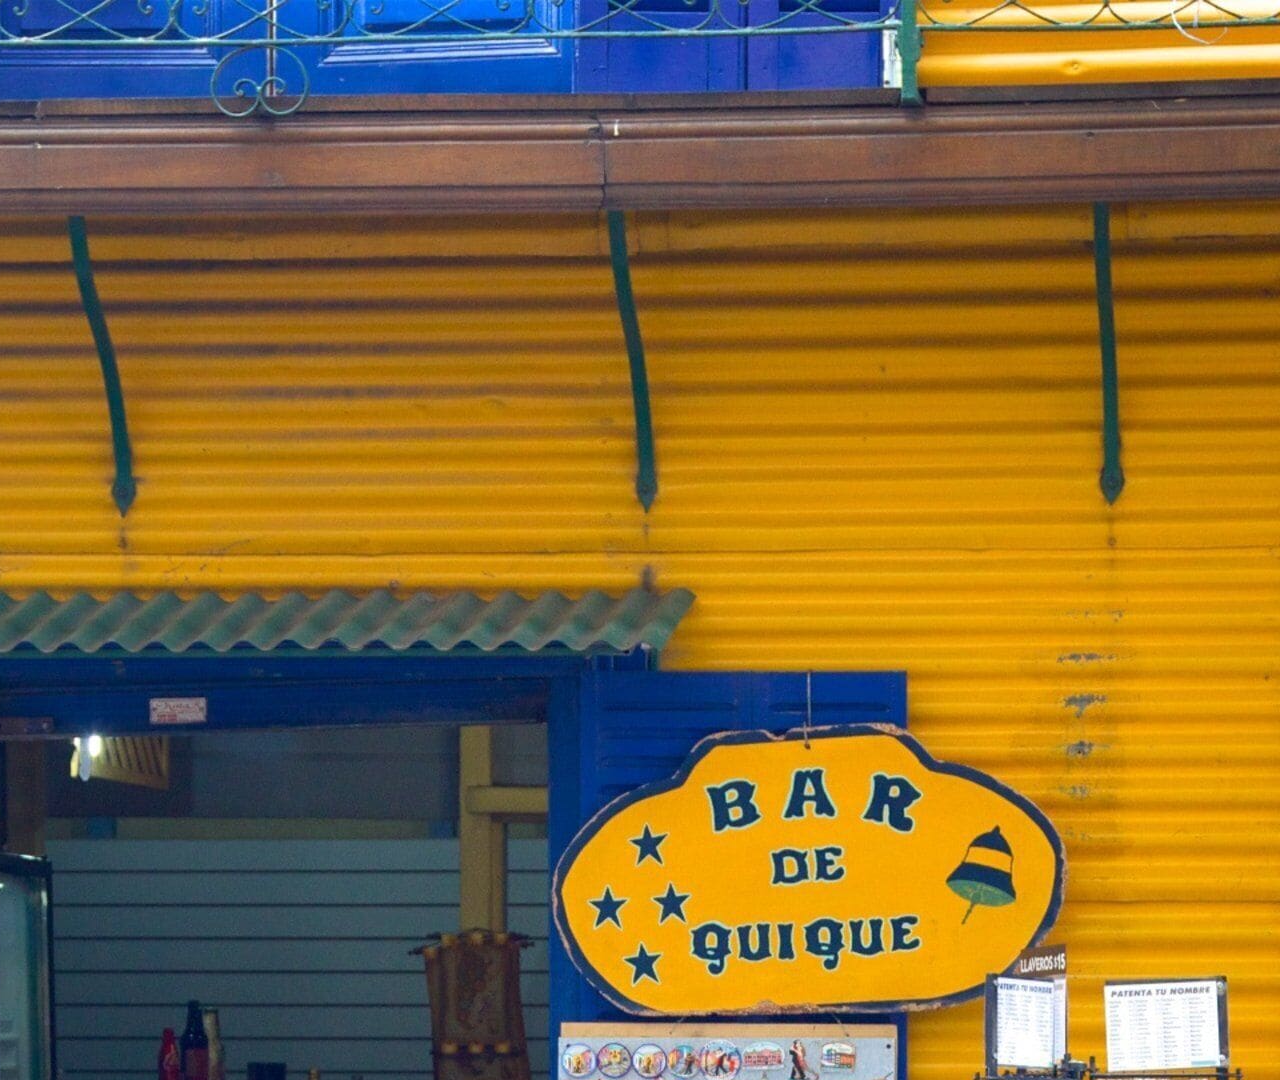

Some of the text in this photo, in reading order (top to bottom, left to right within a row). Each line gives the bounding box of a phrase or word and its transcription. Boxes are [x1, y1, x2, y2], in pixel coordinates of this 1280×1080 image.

[706, 767, 922, 833] BAR
[770, 845, 845, 886] DE
[690, 915, 921, 977] QUIQUE
[1019, 955, 1053, 974] LLAVEROS
[1111, 986, 1211, 998] PATENTA TU NOMBRE
